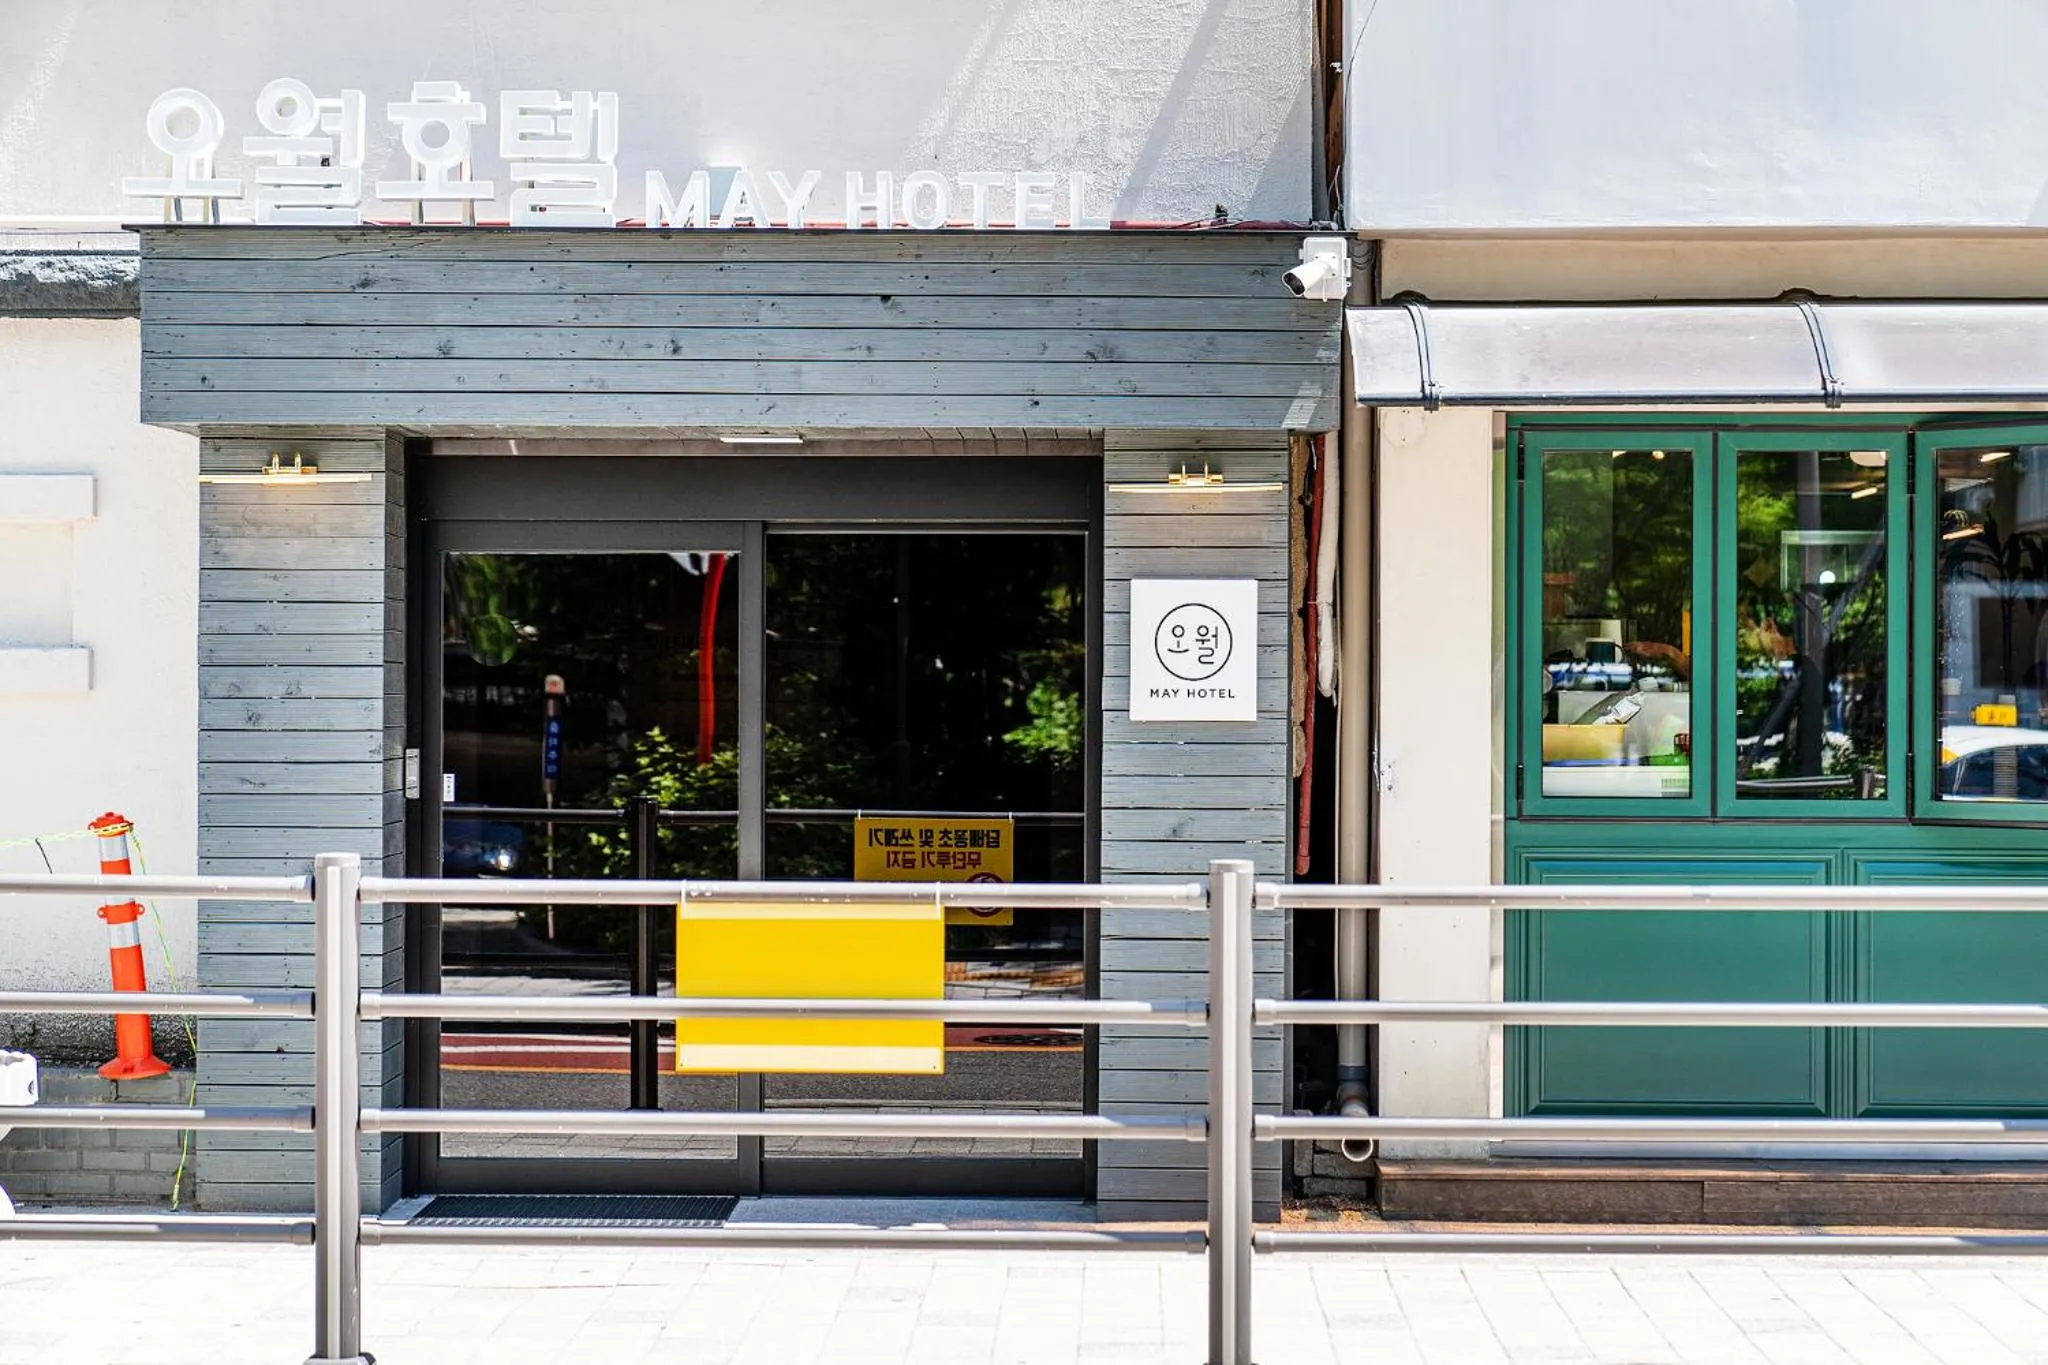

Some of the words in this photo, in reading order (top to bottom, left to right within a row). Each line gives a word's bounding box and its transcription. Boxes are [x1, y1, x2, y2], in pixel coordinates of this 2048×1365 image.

[122, 78, 619, 227] 오월호텔
[645, 169, 821, 229] MAY
[846, 170, 1110, 229] HOTEL
[1167, 624, 1219, 665] 오월
[1150, 688, 1180, 699] MAY
[1187, 688, 1235, 699] HOTEL
